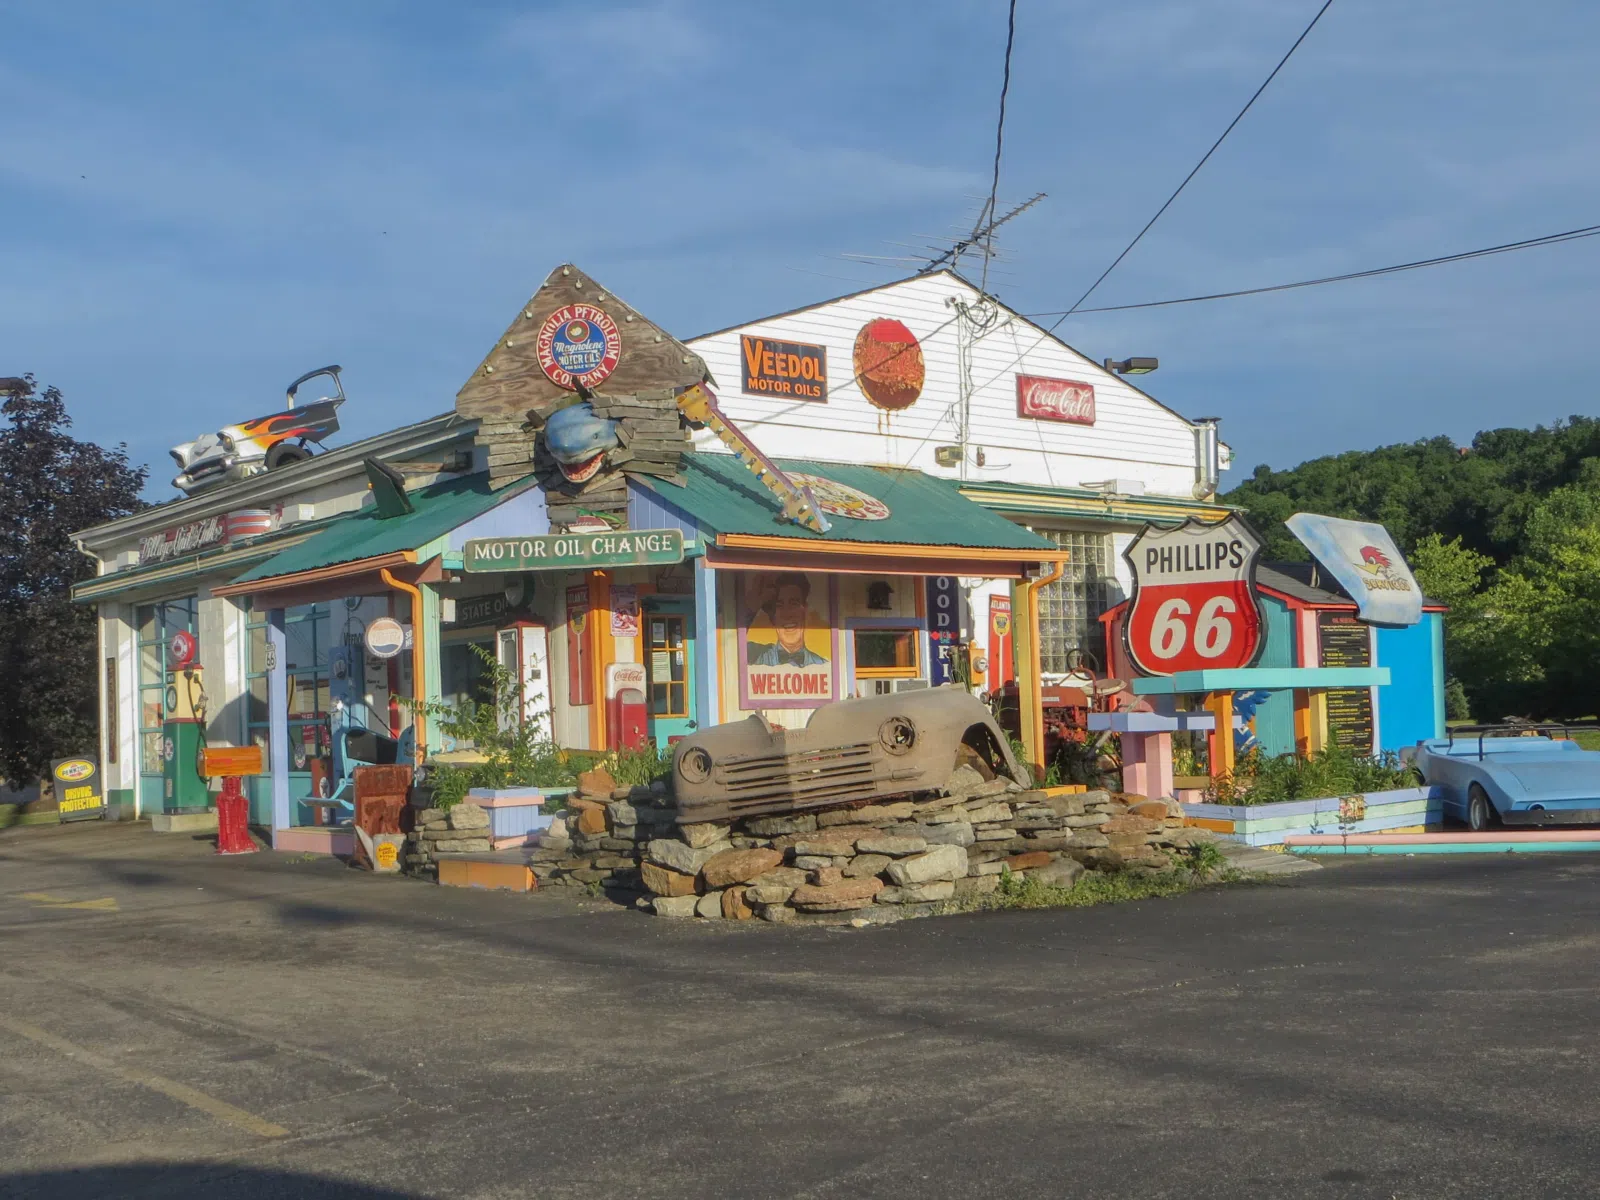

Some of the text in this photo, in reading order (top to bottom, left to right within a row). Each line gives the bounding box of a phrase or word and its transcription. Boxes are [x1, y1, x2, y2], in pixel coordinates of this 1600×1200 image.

[540, 306, 619, 369] MAGNOLIA PETROLEUM
[743, 338, 825, 382] VEEDOL
[748, 377, 821, 397] MOTOR OILS
[474, 534, 673, 560] MOTOR OIL CHANGE
[1146, 539, 1243, 575] PHILLIPS
[1149, 595, 1237, 660] 66
[750, 673, 828, 695] WELCOME
